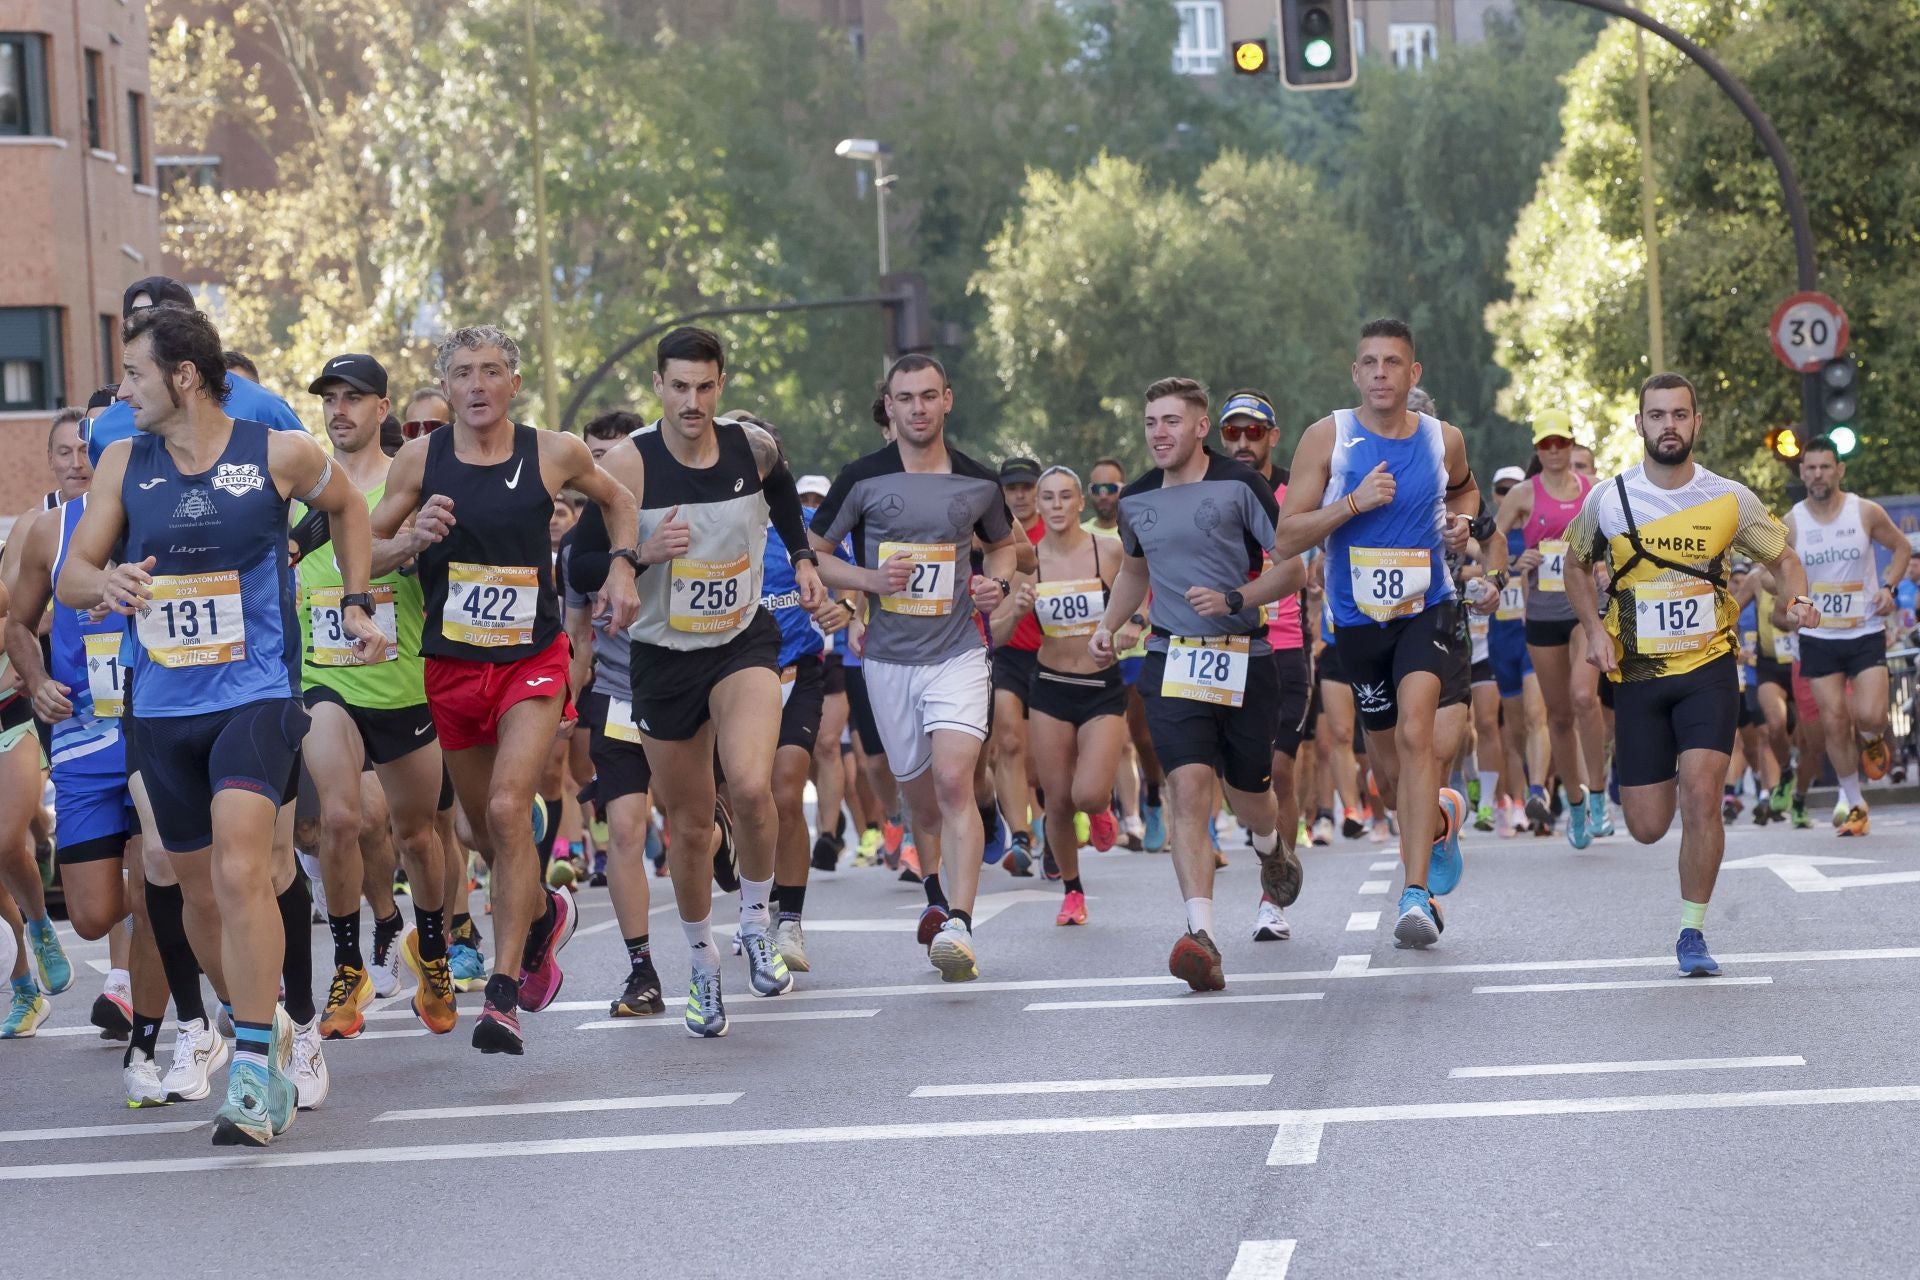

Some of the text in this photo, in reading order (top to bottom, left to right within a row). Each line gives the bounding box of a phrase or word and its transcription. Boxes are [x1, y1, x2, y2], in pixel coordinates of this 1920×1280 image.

[1790, 319, 1827, 346] 30
[219, 475, 258, 485] VETUSTA
[1639, 536, 1707, 551] UMBRE
[1804, 547, 1861, 566] bathco
[176, 587, 198, 596] 2024
[484, 575, 504, 583] 2024
[1372, 568, 1404, 599] 38
[462, 585, 518, 622] 422
[689, 578, 738, 610] 258
[1050, 594, 1089, 620] 289
[1822, 593, 1853, 613] 287
[160, 598, 218, 638] 131
[471, 620, 492, 628] CARLOS
[1654, 598, 1700, 631] 152
[1187, 649, 1231, 682] 128
